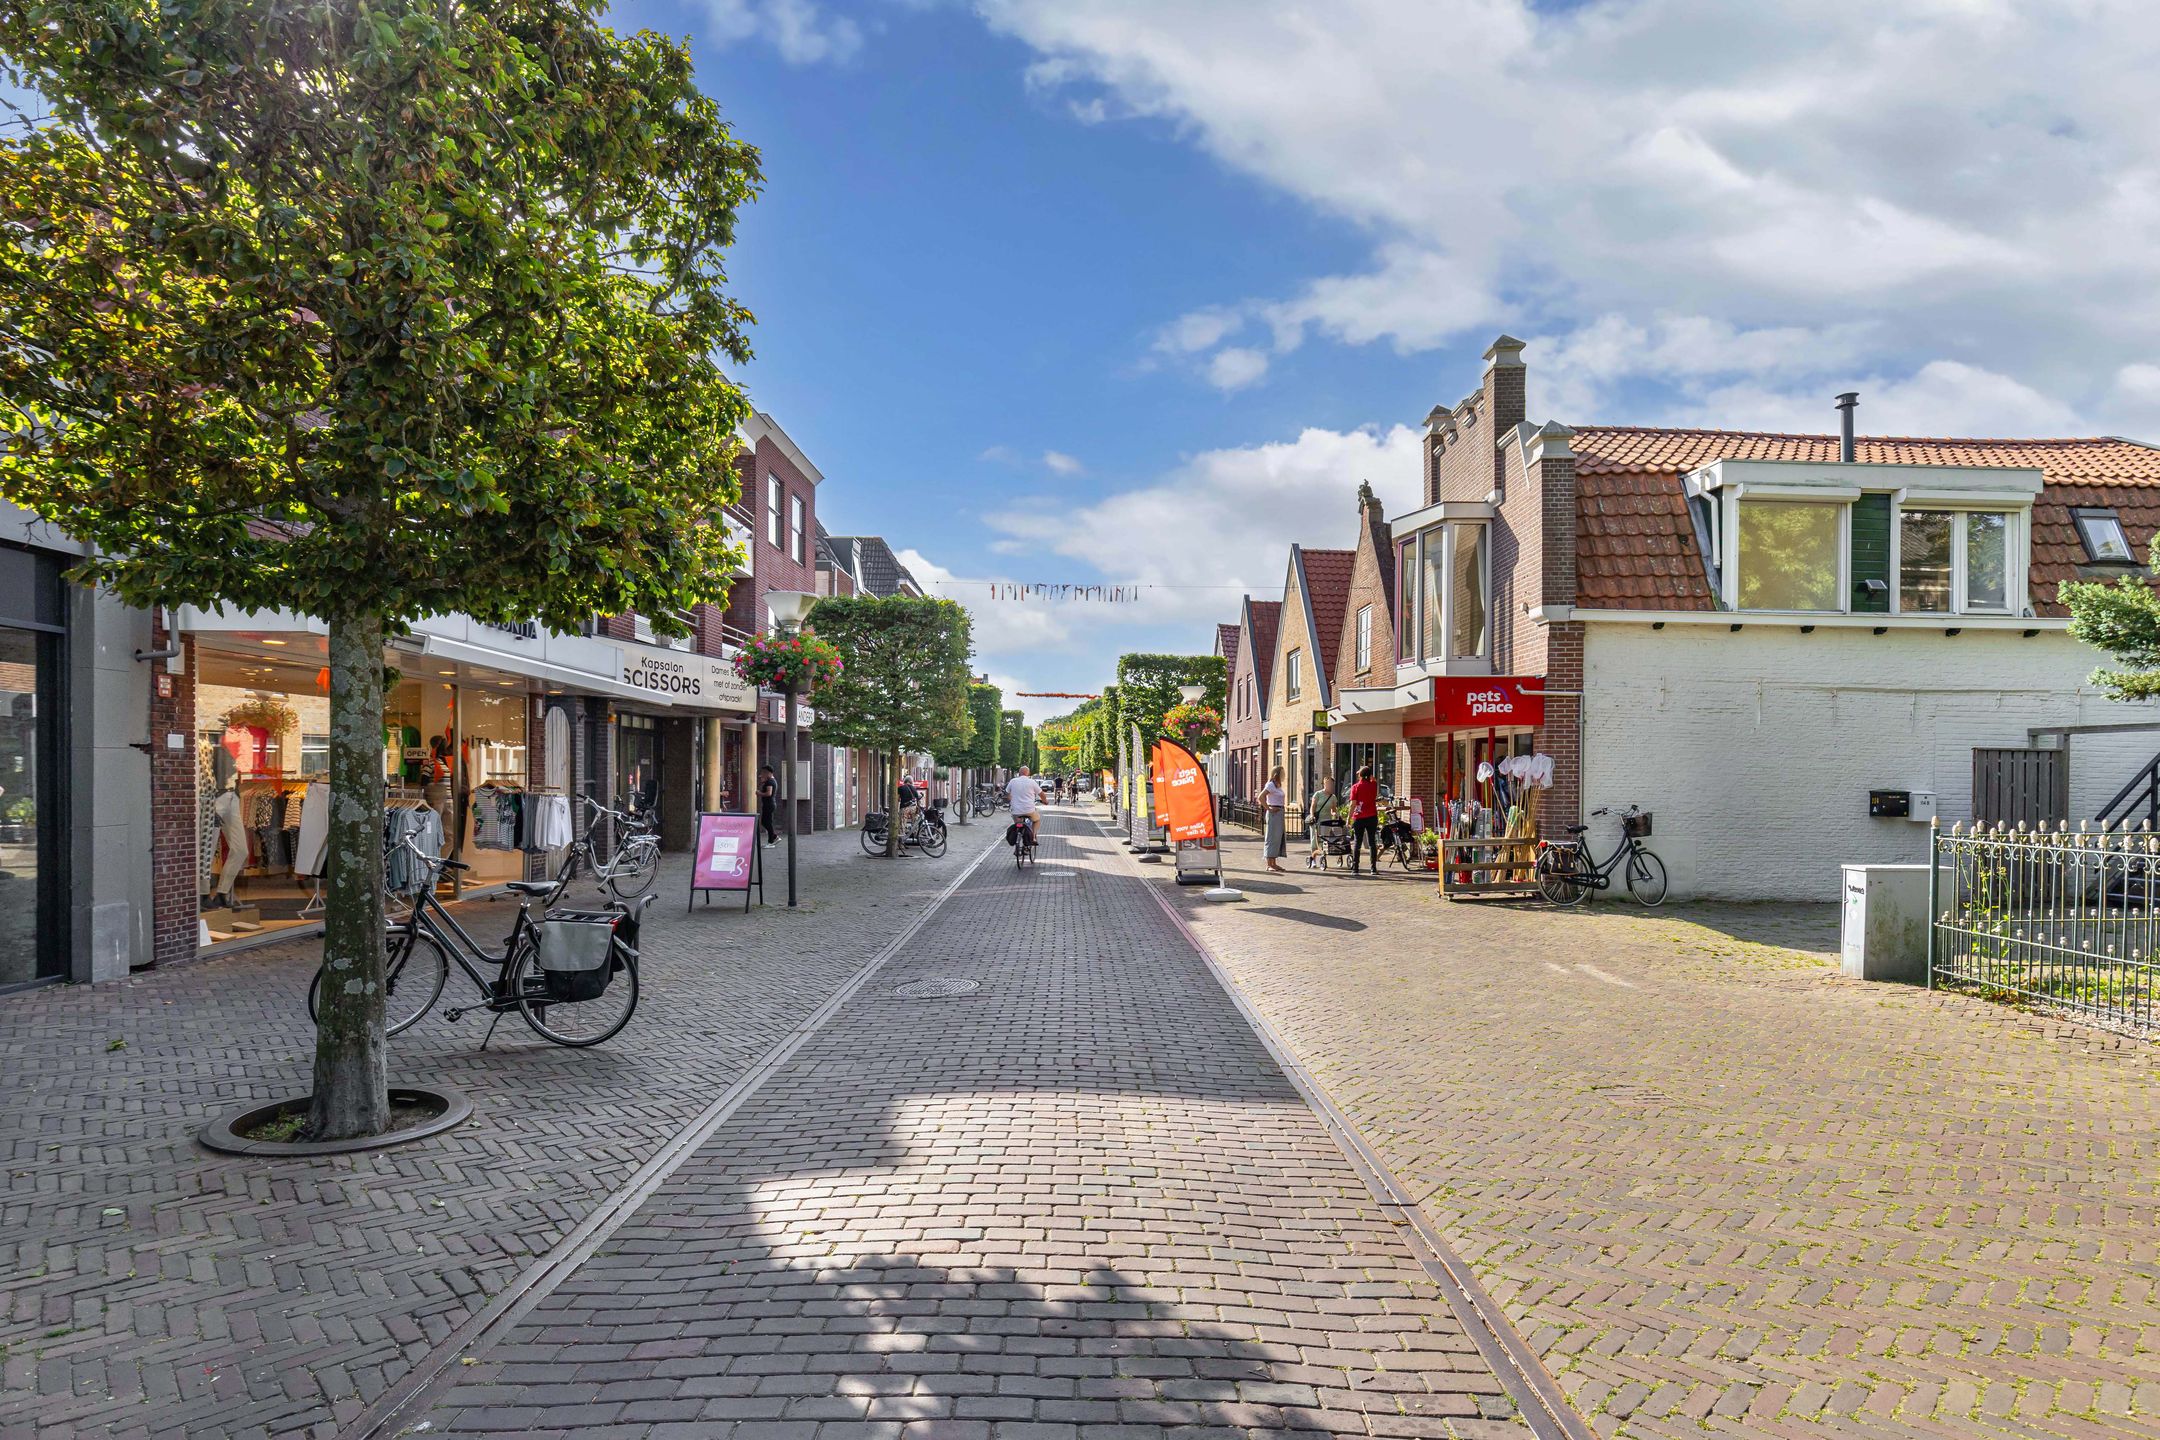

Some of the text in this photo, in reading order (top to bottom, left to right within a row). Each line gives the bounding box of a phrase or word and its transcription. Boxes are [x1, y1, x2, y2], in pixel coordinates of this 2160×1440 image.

[641, 656, 684, 673] Kapsalon
[711, 665, 730, 677] Dames
[624, 667, 700, 695] SCISSORS
[714, 680, 724, 688] met
[724, 681, 730, 689] of
[1466, 690, 1501, 705] pets
[1472, 702, 1513, 716] place
